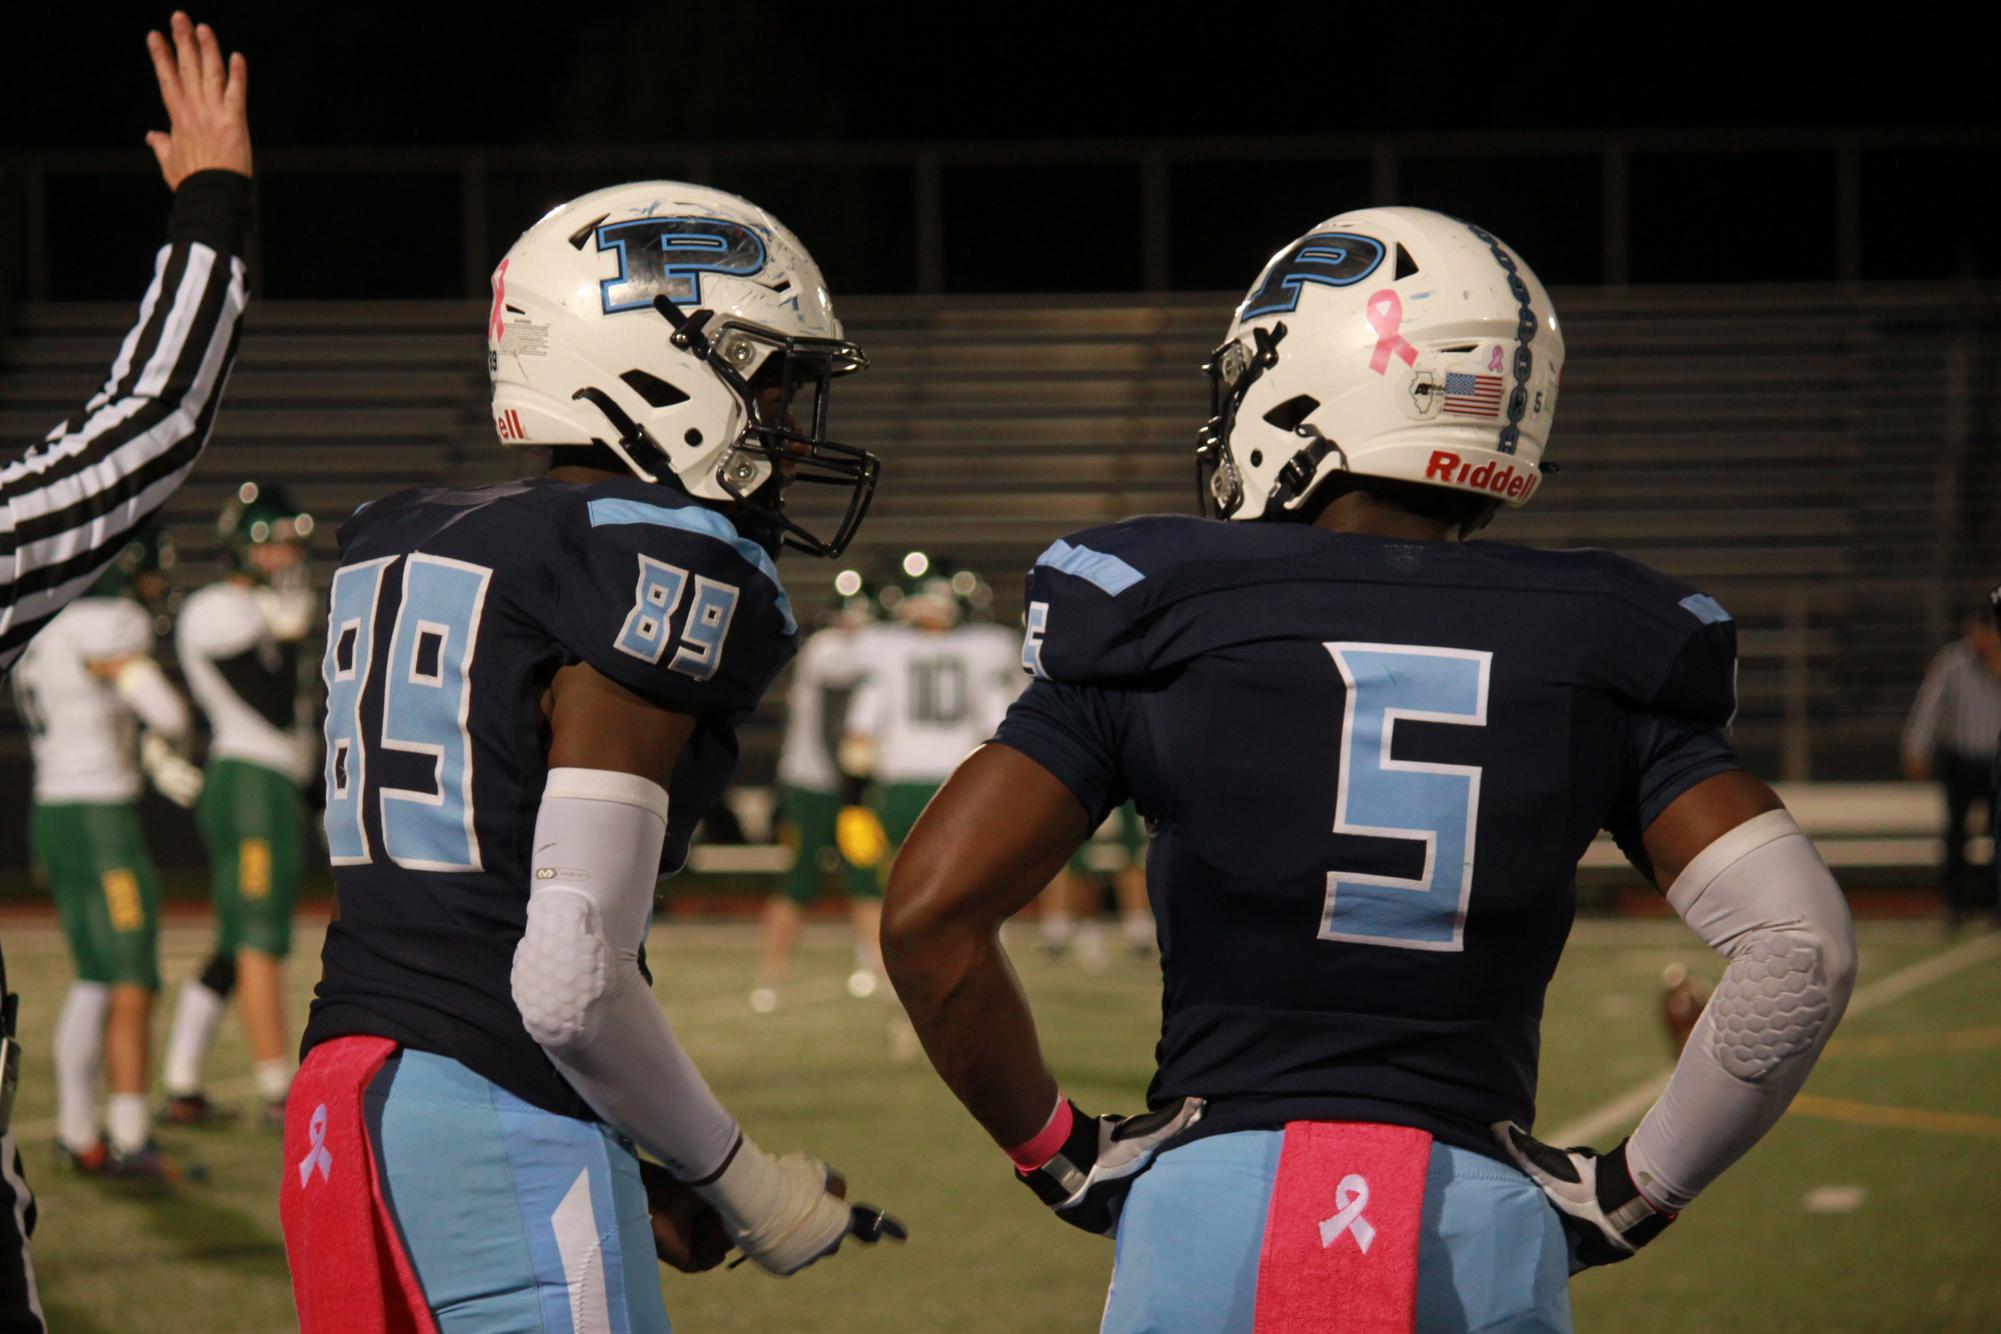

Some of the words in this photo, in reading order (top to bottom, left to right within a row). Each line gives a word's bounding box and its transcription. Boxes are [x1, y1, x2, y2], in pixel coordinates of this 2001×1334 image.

[596, 216, 767, 315] P
[1240, 231, 1387, 323] P
[1425, 450, 1538, 501] Riddell
[613, 553, 740, 681] 89
[323, 550, 494, 873] 89
[908, 654, 968, 728] 10
[1315, 641, 1493, 953] 5
